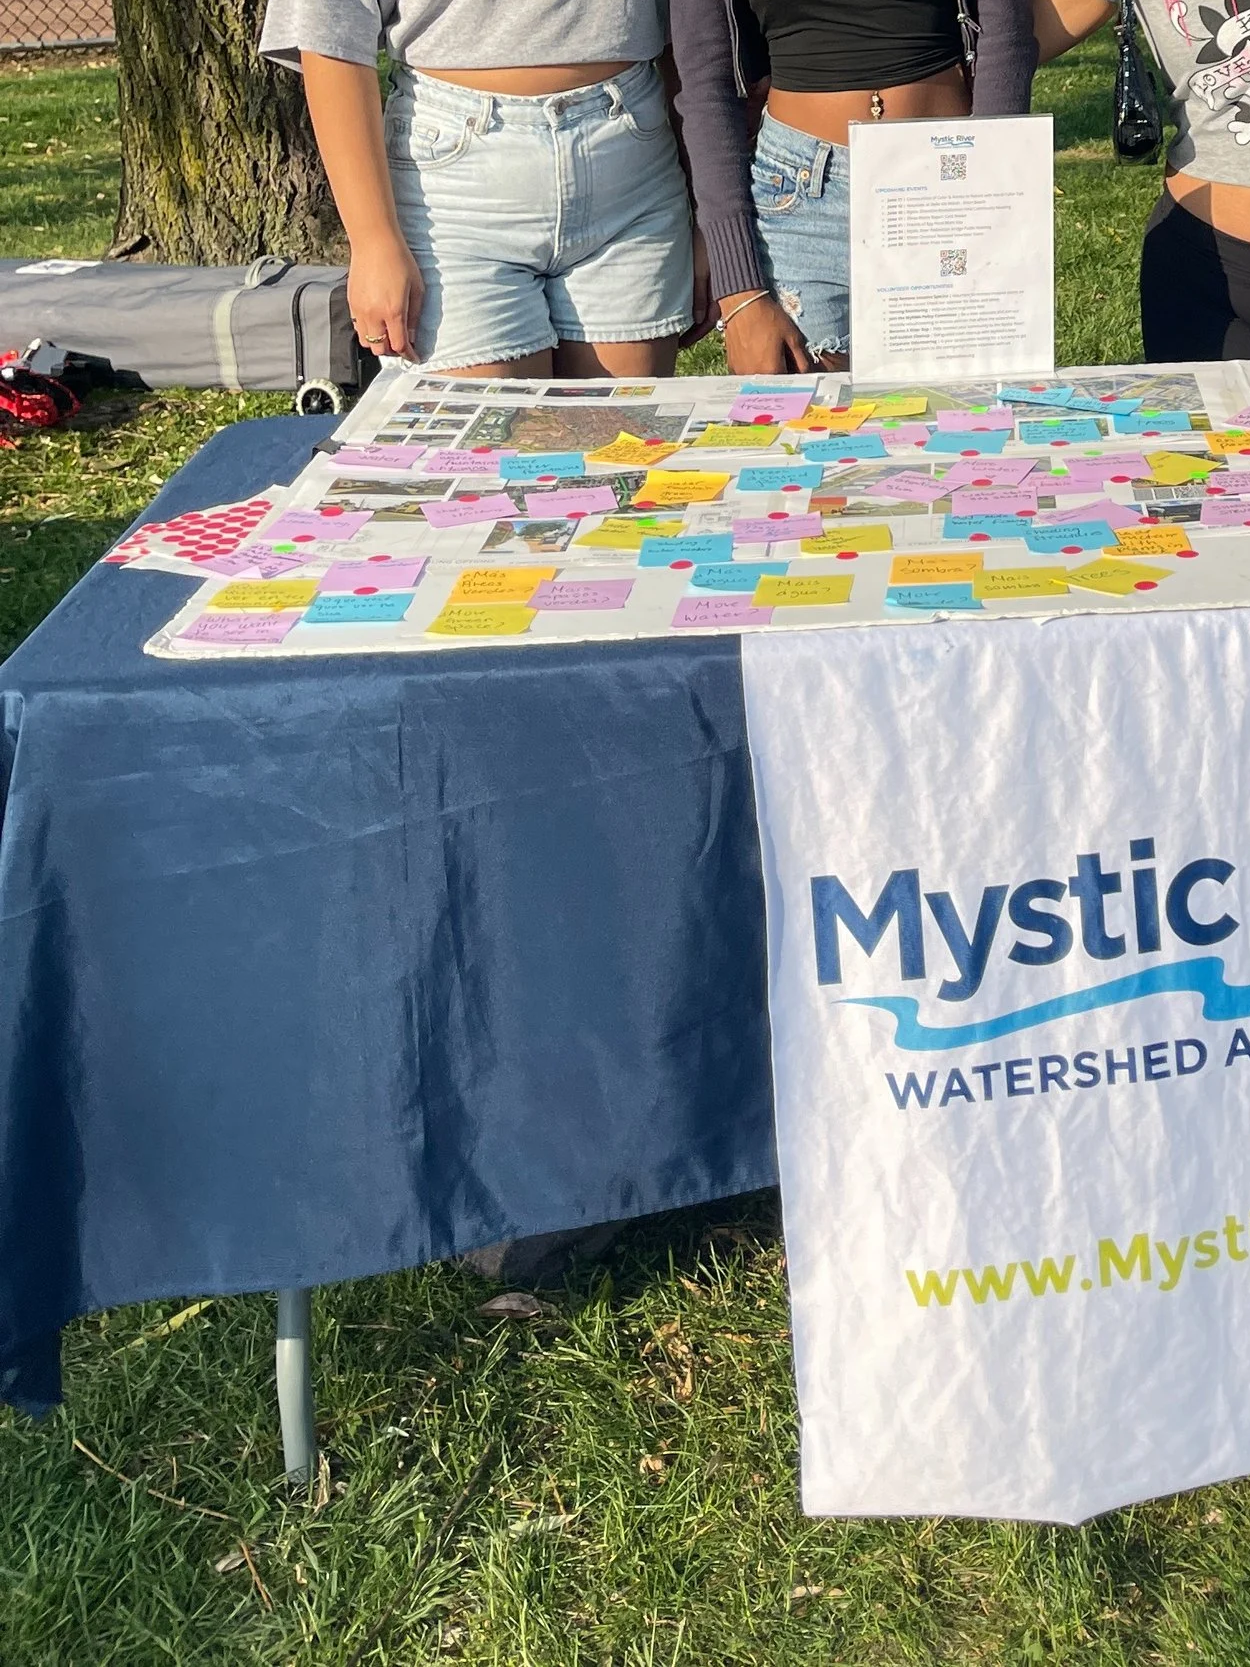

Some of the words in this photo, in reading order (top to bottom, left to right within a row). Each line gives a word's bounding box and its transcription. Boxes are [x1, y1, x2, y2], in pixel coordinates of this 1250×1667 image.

[930, 135, 954, 143] Mystic
[1066, 567, 1131, 582] Trees
[810, 838, 1241, 1003] Mystic
[885, 1038, 1208, 1111] WATERSHED
